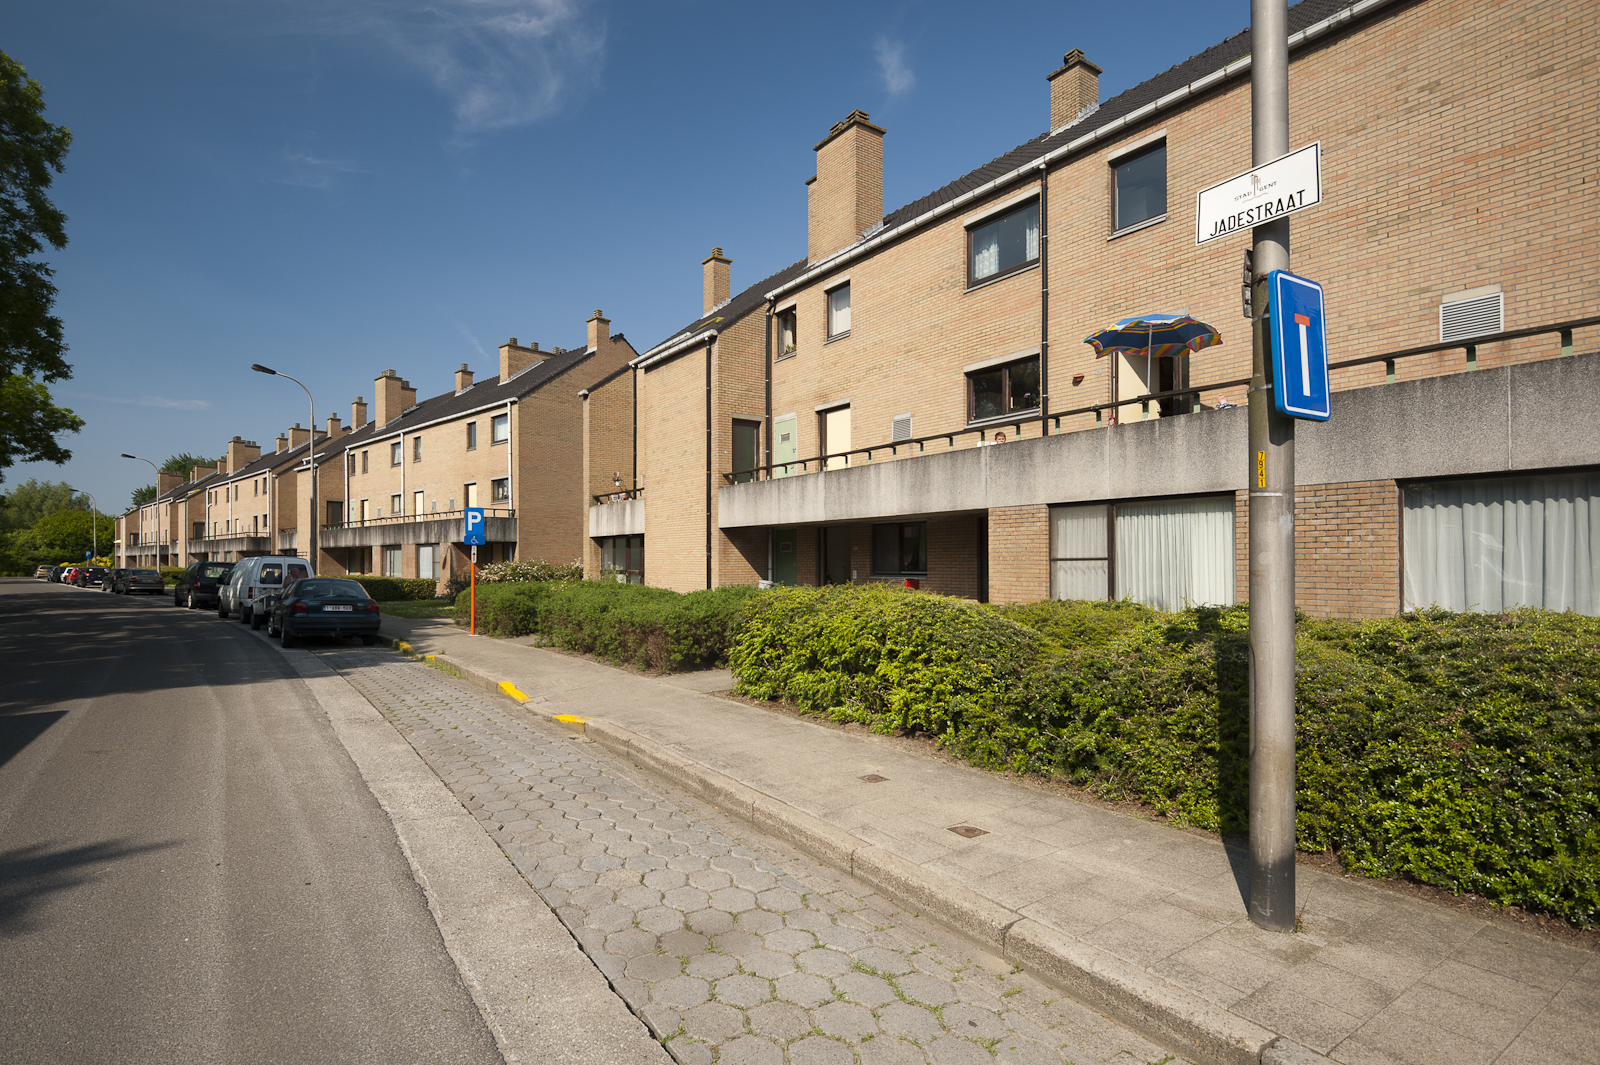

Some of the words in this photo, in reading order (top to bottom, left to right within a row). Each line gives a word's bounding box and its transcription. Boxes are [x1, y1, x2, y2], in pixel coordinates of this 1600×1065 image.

[1234, 191, 1252, 202] STAD
[1259, 181, 1277, 192] GENT
[1209, 189, 1306, 237] JADESTRAAT
[468, 511, 482, 531] P
